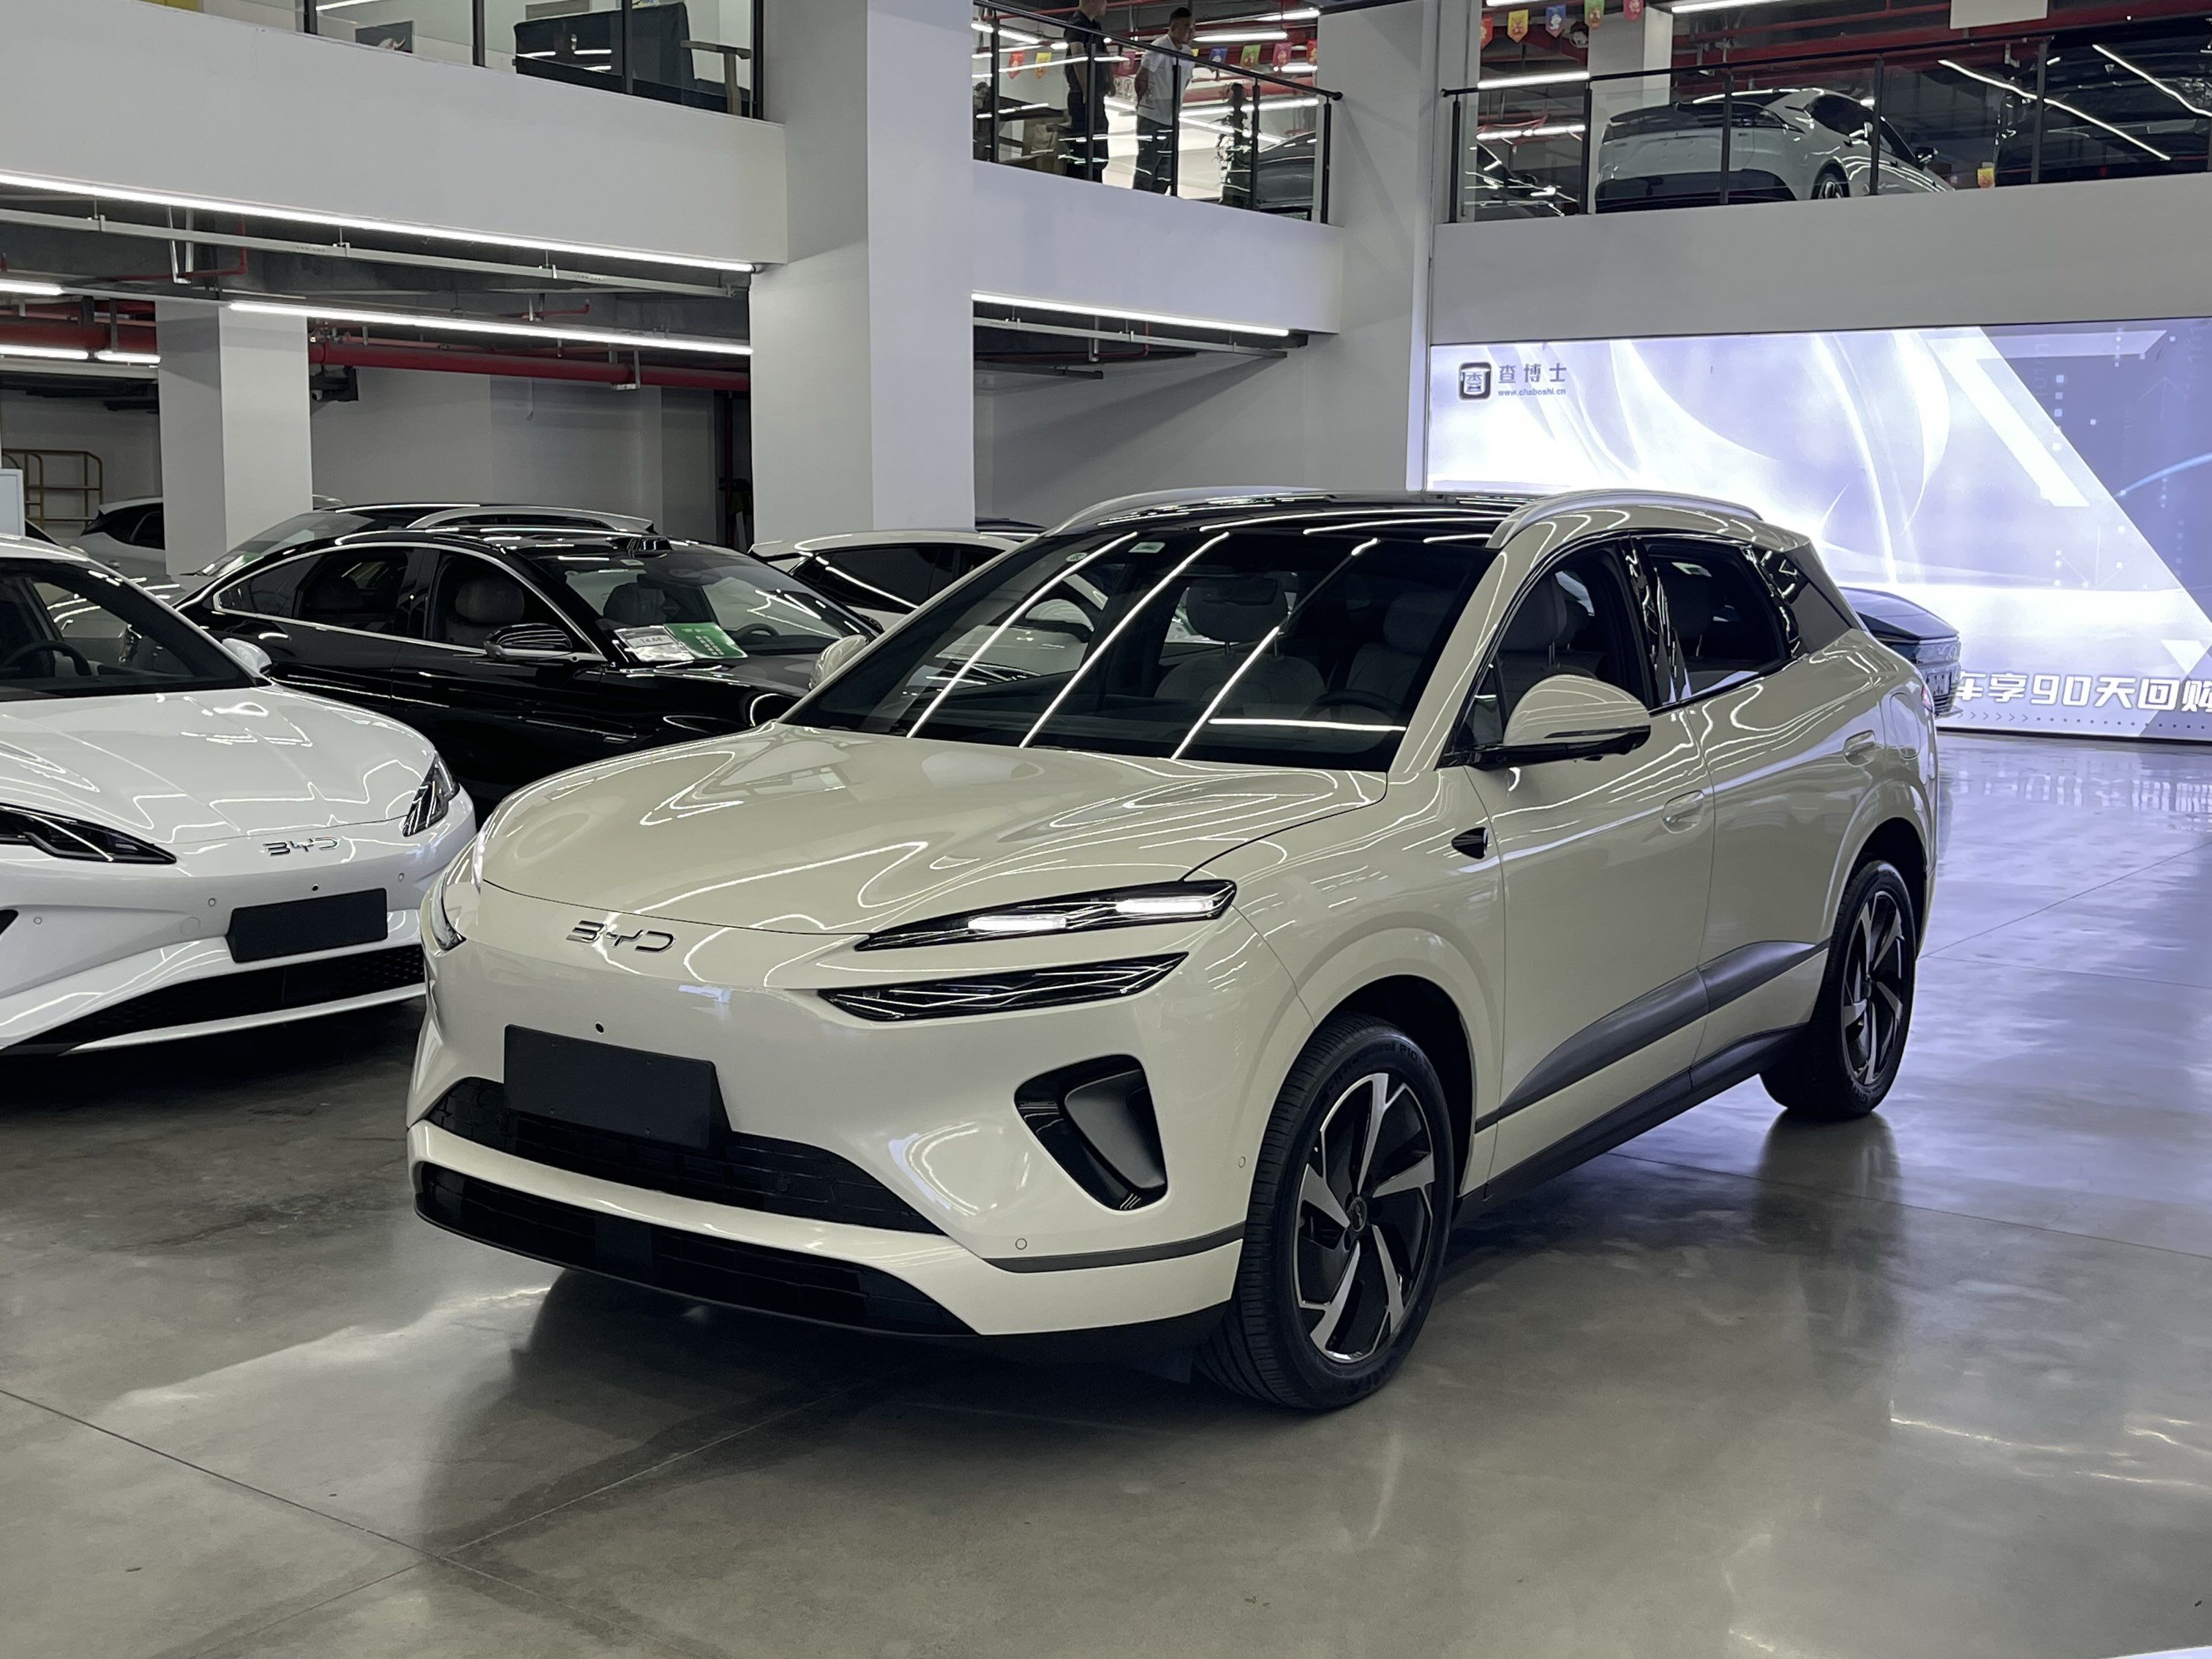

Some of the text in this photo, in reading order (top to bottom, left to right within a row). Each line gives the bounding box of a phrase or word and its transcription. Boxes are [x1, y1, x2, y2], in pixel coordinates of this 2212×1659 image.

[1498, 363, 1567, 383] 查博士
[1497, 388, 1567, 396] www.chaboshi.cn
[262, 836, 341, 857] BYD
[565, 919, 677, 954] BYD
